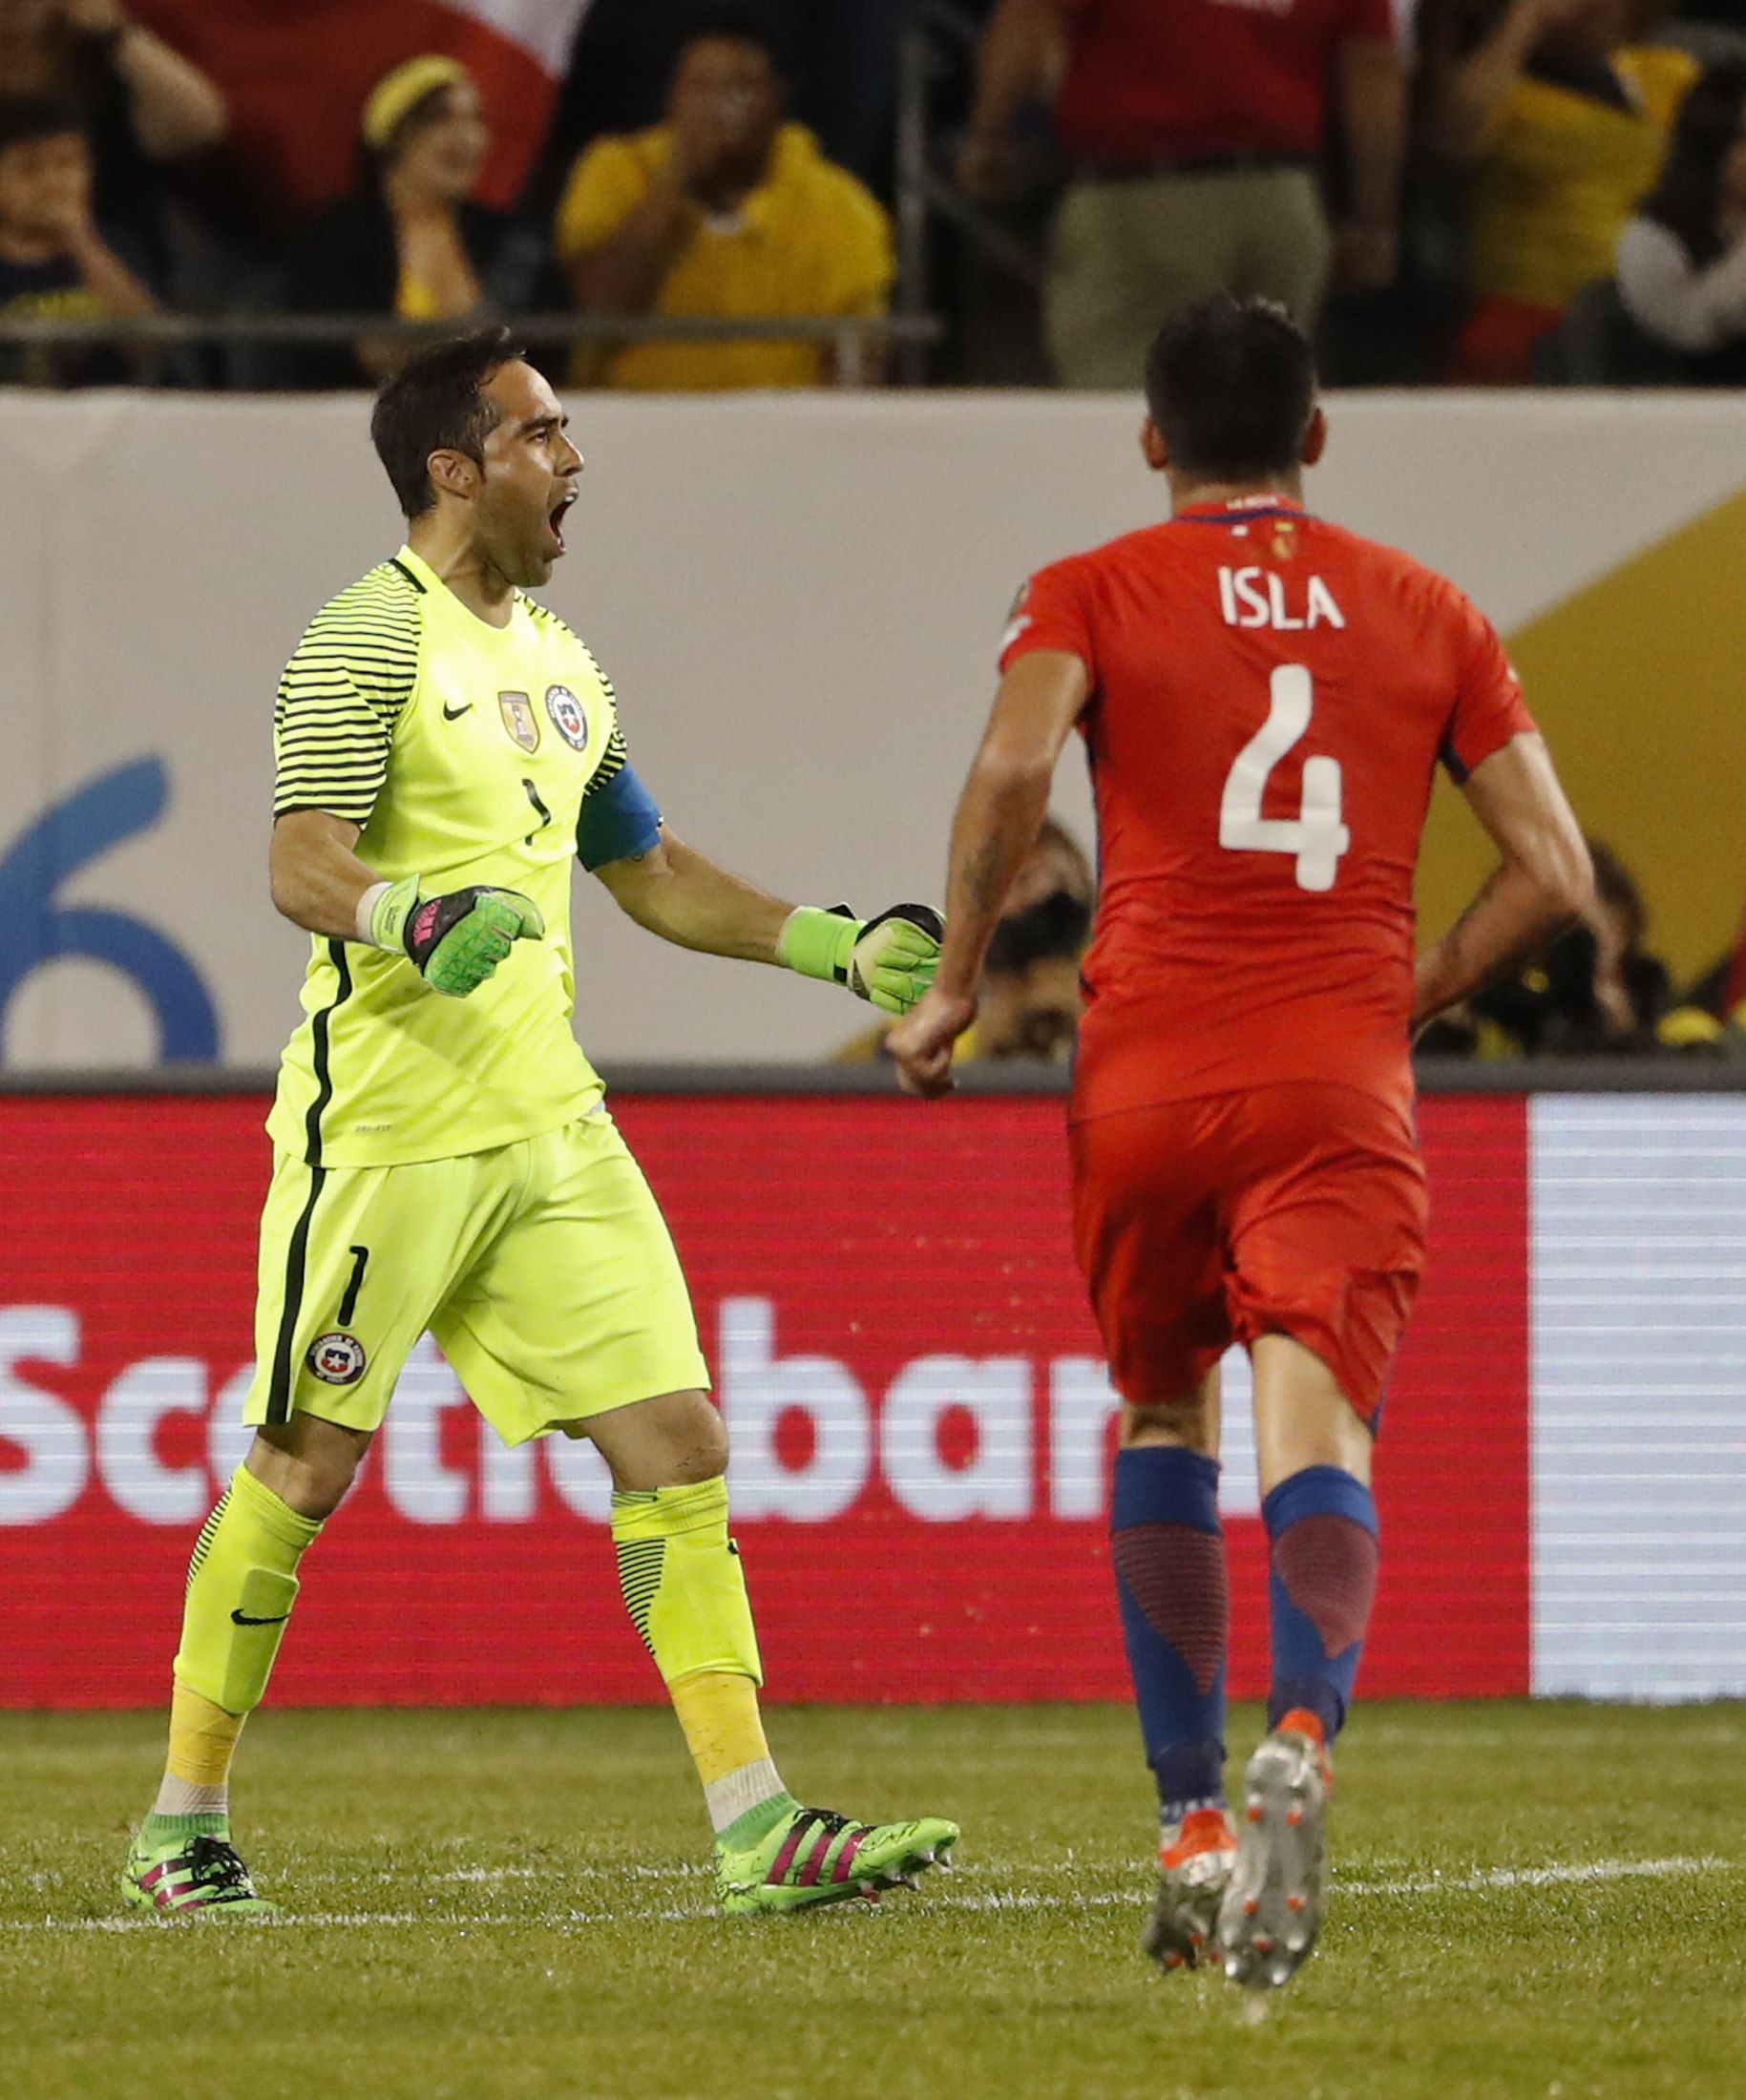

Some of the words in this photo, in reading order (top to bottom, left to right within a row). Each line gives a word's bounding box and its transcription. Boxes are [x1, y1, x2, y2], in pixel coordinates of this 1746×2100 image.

[1218, 566, 1345, 630] ISLA
[521, 778, 552, 846] 1
[1219, 663, 1351, 892] 4
[337, 1246, 369, 1327] 1
[0, 1295, 1262, 1525] Sctban
